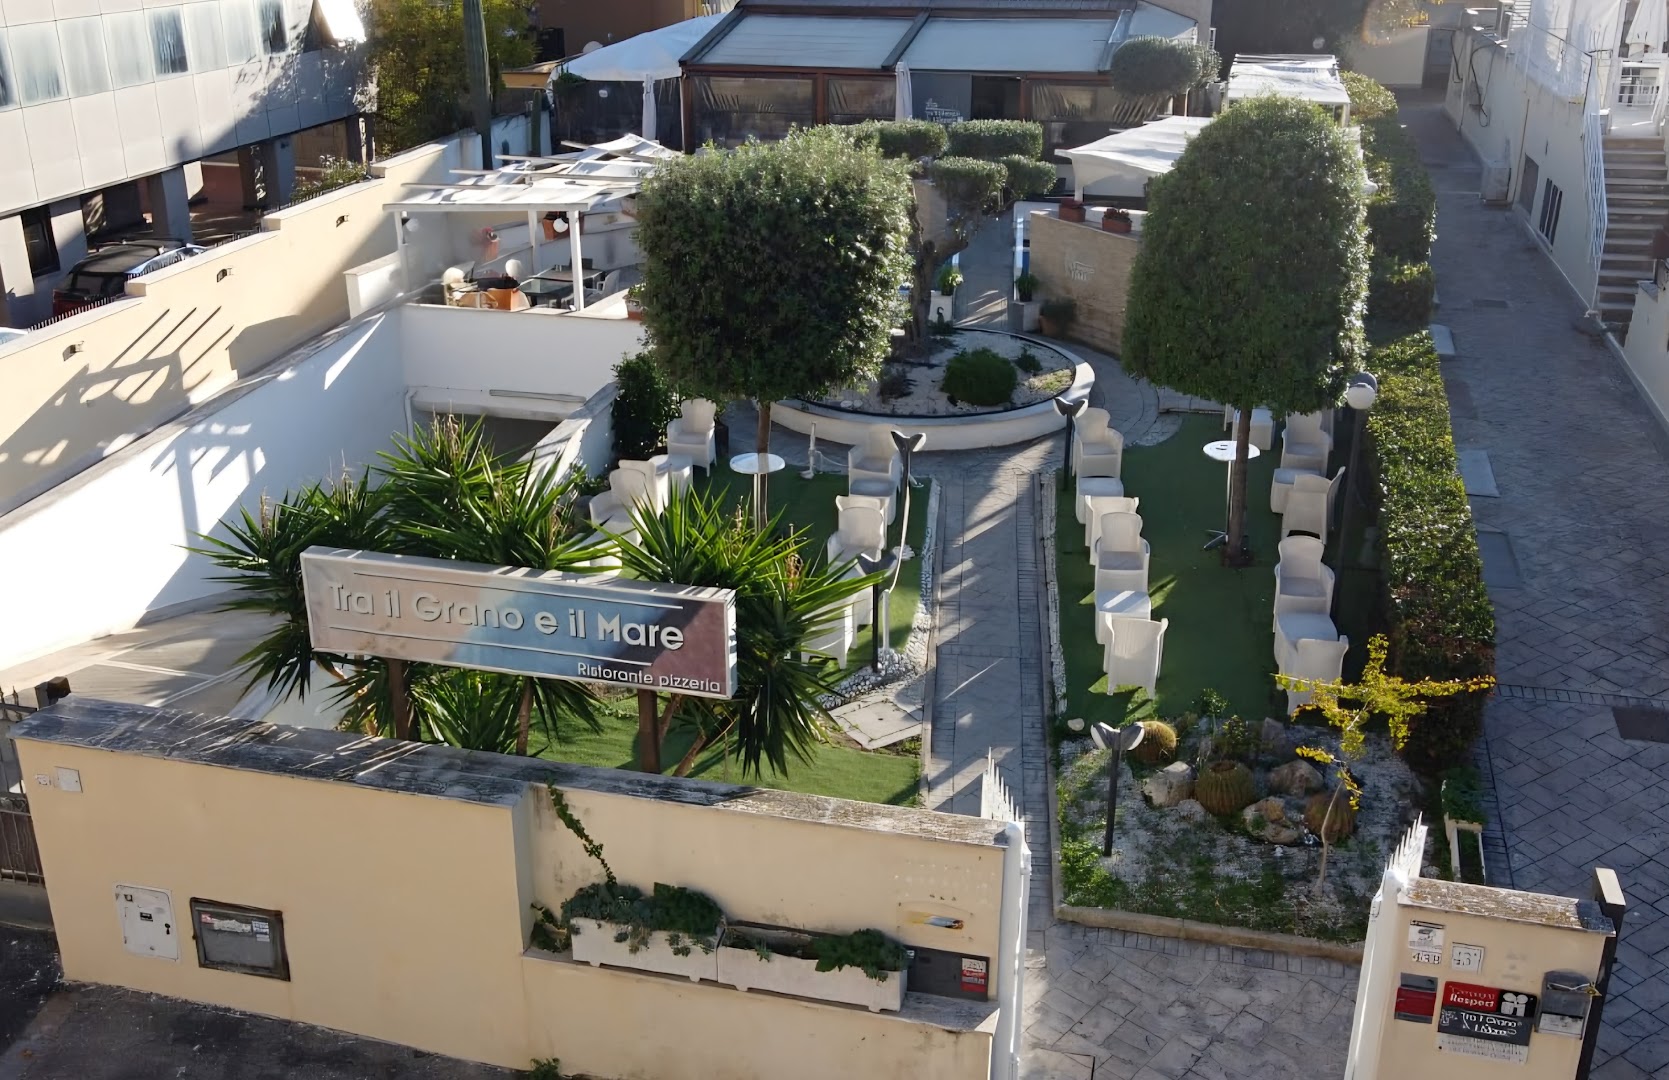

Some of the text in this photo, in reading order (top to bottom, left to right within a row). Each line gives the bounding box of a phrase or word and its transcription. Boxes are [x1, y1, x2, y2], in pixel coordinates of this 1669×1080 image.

[328, 581, 684, 651] Tra il Grano e il Mare
[577, 661, 721, 693] Ristorante pizzeria
